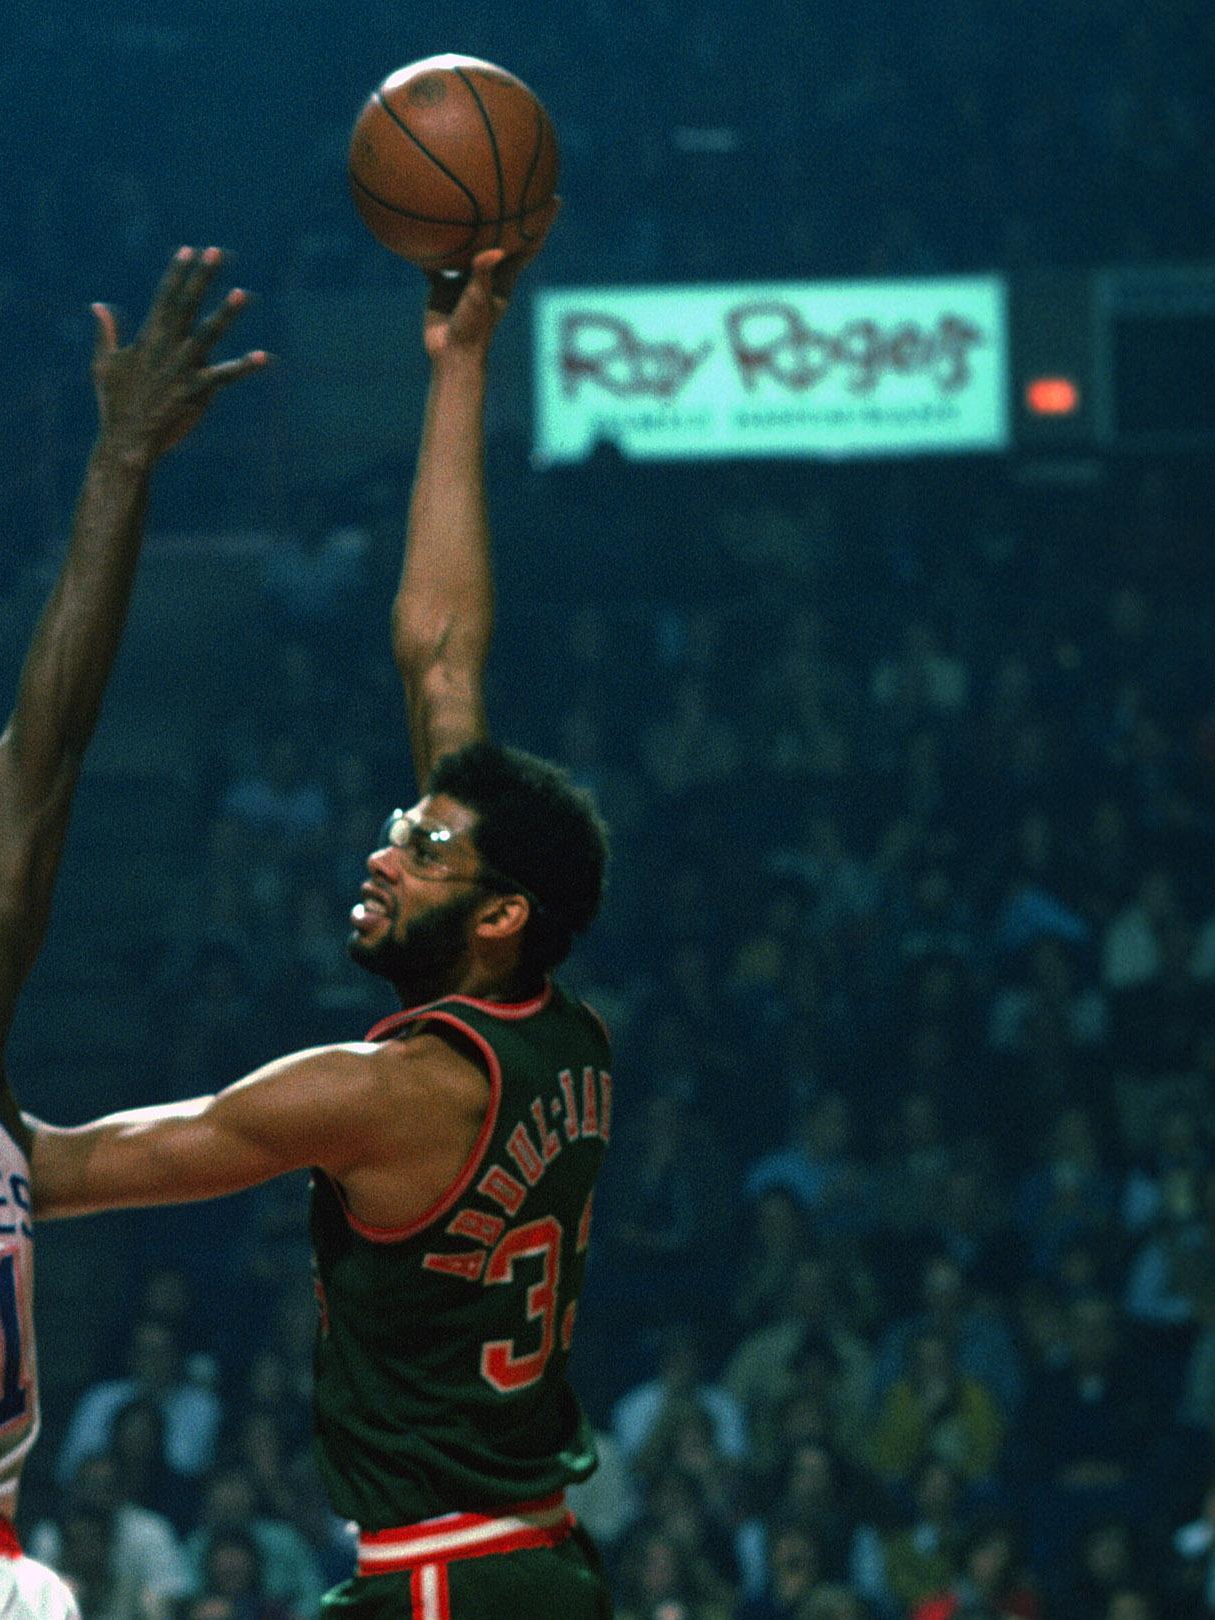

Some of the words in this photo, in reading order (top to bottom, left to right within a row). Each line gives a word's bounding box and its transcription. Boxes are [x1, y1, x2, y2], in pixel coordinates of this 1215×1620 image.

[559, 311, 713, 401] Roy
[724, 299, 985, 396] Rogers
[480, 1194, 595, 1393] 3
